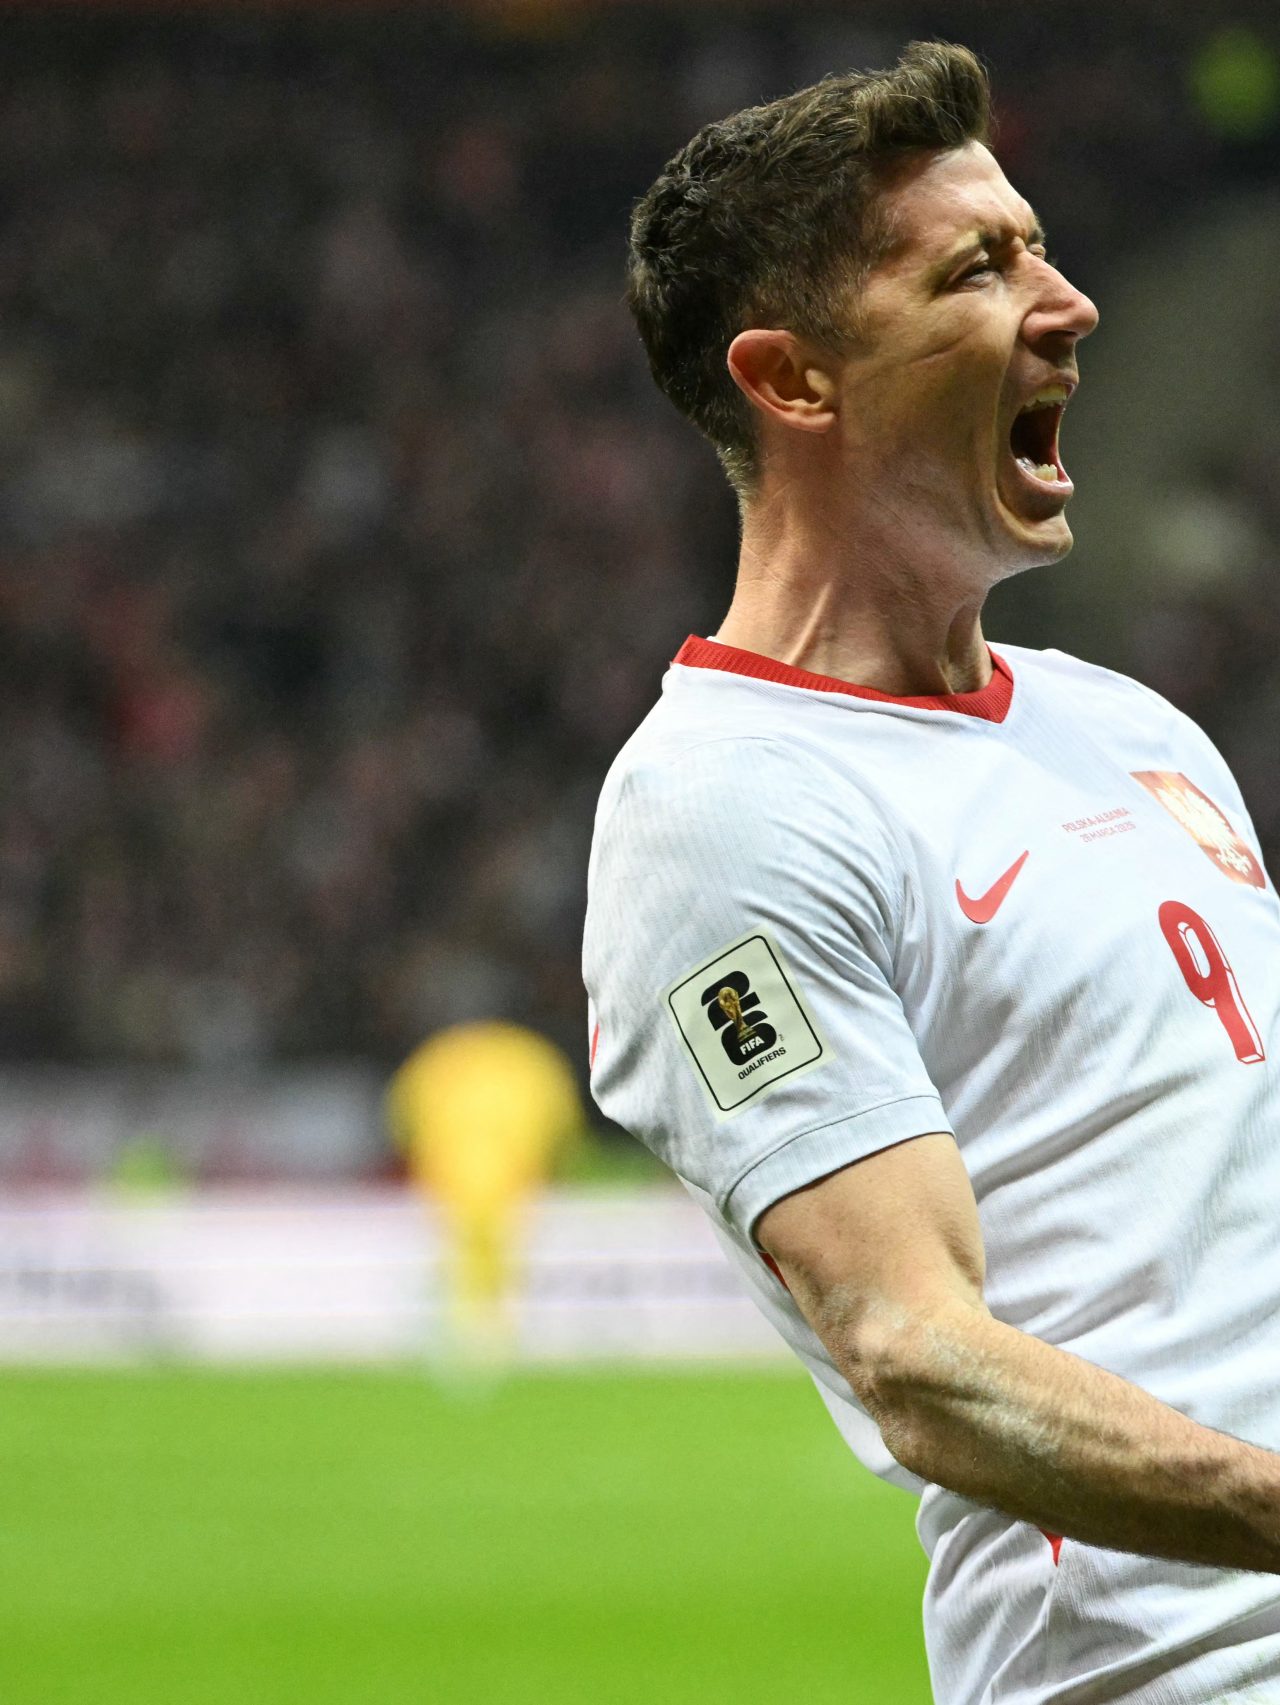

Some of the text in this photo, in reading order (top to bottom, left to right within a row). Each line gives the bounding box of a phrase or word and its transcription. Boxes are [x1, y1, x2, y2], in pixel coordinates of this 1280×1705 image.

[1158, 900, 1266, 1064] 9
[737, 1046, 787, 1080] QUALIFIERS
[738, 1036, 765, 1056] FIFA
